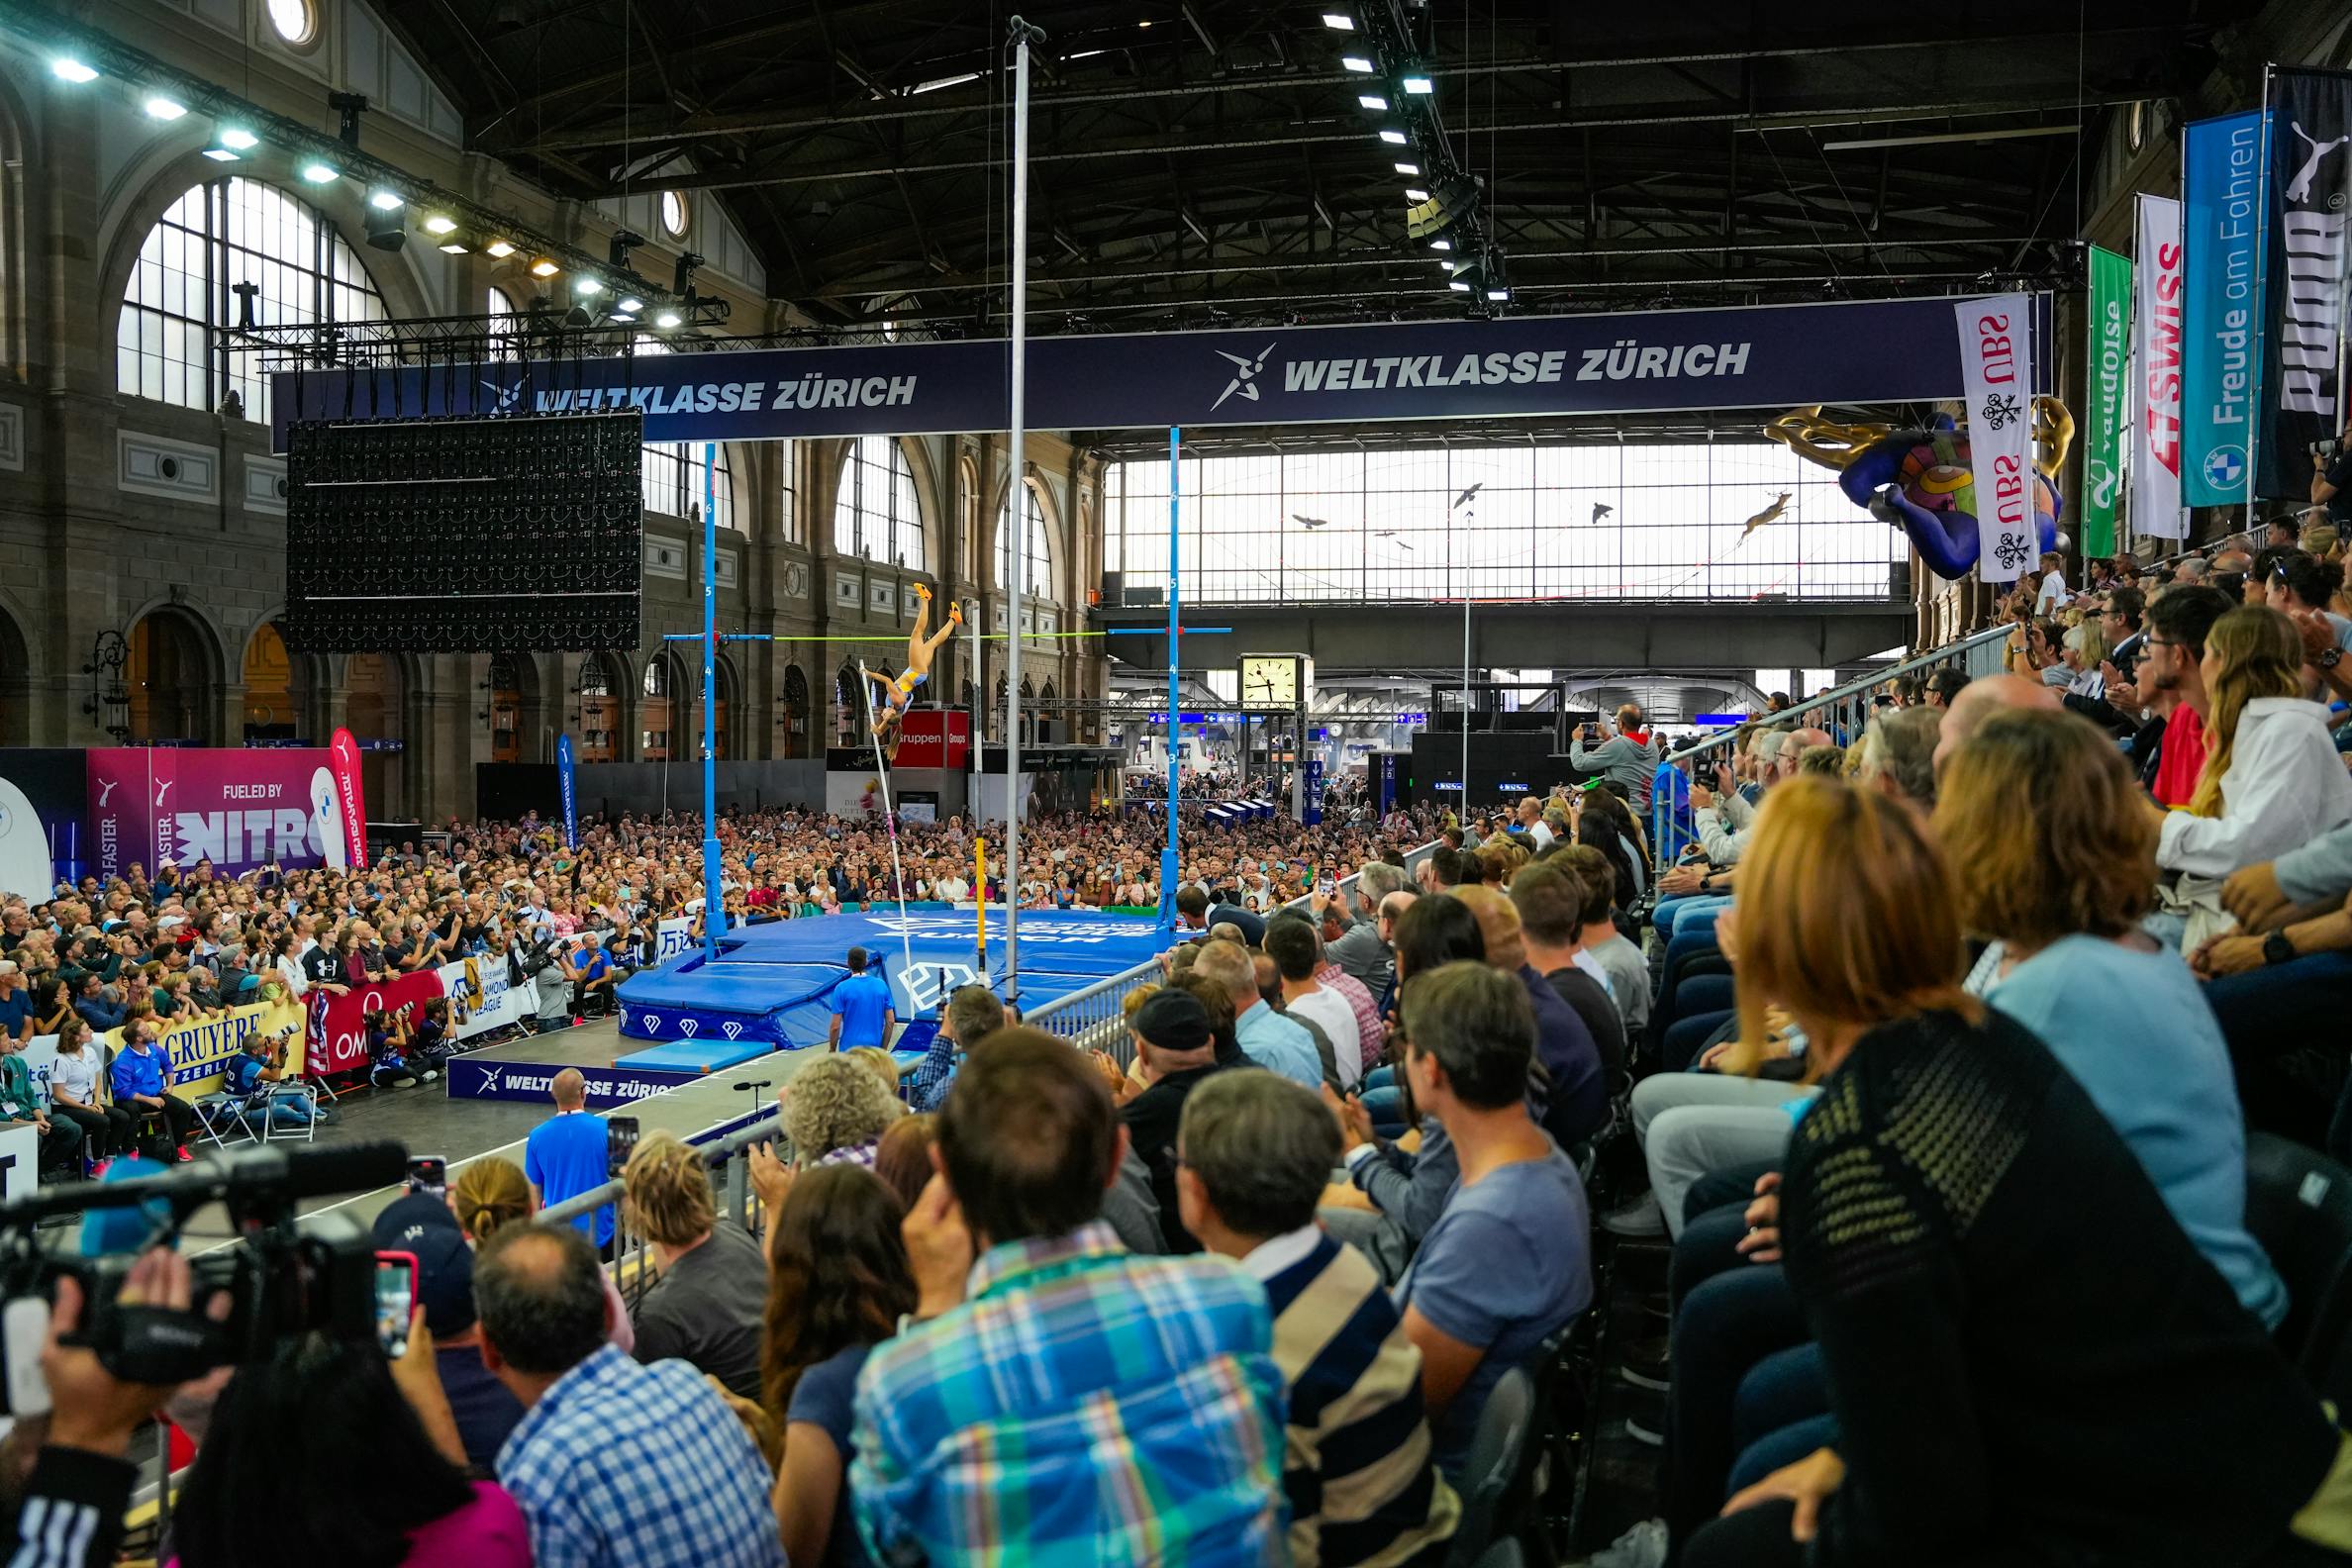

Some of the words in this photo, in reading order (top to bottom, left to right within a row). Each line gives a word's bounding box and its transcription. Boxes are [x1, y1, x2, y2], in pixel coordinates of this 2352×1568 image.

[2219, 127, 2254, 243] Fahren
[2225, 247, 2249, 300] am
[2148, 243, 2180, 403] SWISS
[2281, 210, 2346, 415] PUMA
[1285, 350, 1567, 392] WELTKLASSE
[1576, 340, 1751, 381] ZÜRICH
[2104, 300, 2120, 449] vaudoise
[2212, 308, 2248, 426] Freude
[773, 372, 917, 410] ZÜRICH
[705, 504, 712, 513] 6
[705, 586, 712, 597] 5
[1170, 578, 1176, 589] 5
[705, 666, 712, 676] 4
[1169, 664, 1176, 674] 4
[948, 734, 966, 744] Groups
[705, 749, 712, 759] 3
[1169, 753, 1176, 764] 3
[223, 784, 266, 800] FUELED
[267, 783, 283, 798] BY
[101, 813, 117, 883] R.FASTER.
[158, 812, 172, 864] ASTER.
[505, 1075, 612, 1096] WELTSSE
